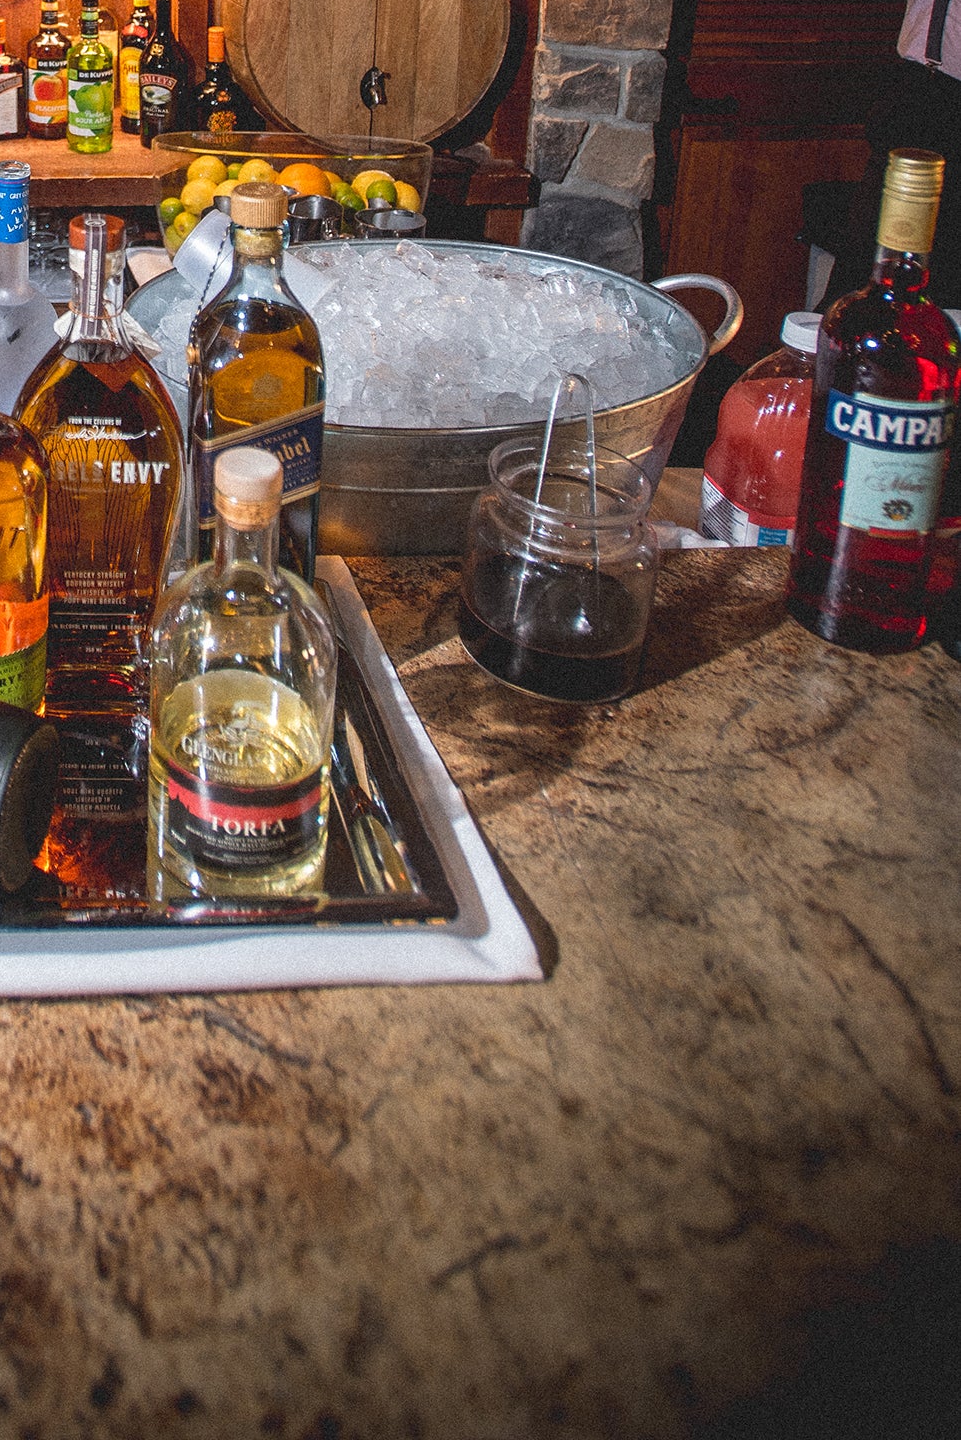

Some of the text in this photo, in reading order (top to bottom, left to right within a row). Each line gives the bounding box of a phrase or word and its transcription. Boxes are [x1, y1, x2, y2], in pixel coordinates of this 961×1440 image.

[48, 59, 68, 67] KUYP
[83, 417, 92, 425] THE
[263, 428, 299, 445] WALKER
[110, 461, 164, 485] ENVY
[63, 571, 127, 579] KENTUCKY STRAIGHT
[66, 580, 125, 588] BOURBON WHISKEY
[76, 588, 114, 596] FINISHED IN
[63, 597, 80, 605] PORT
[81, 597, 97, 605] WINE
[211, 814, 286, 837] TORFA
